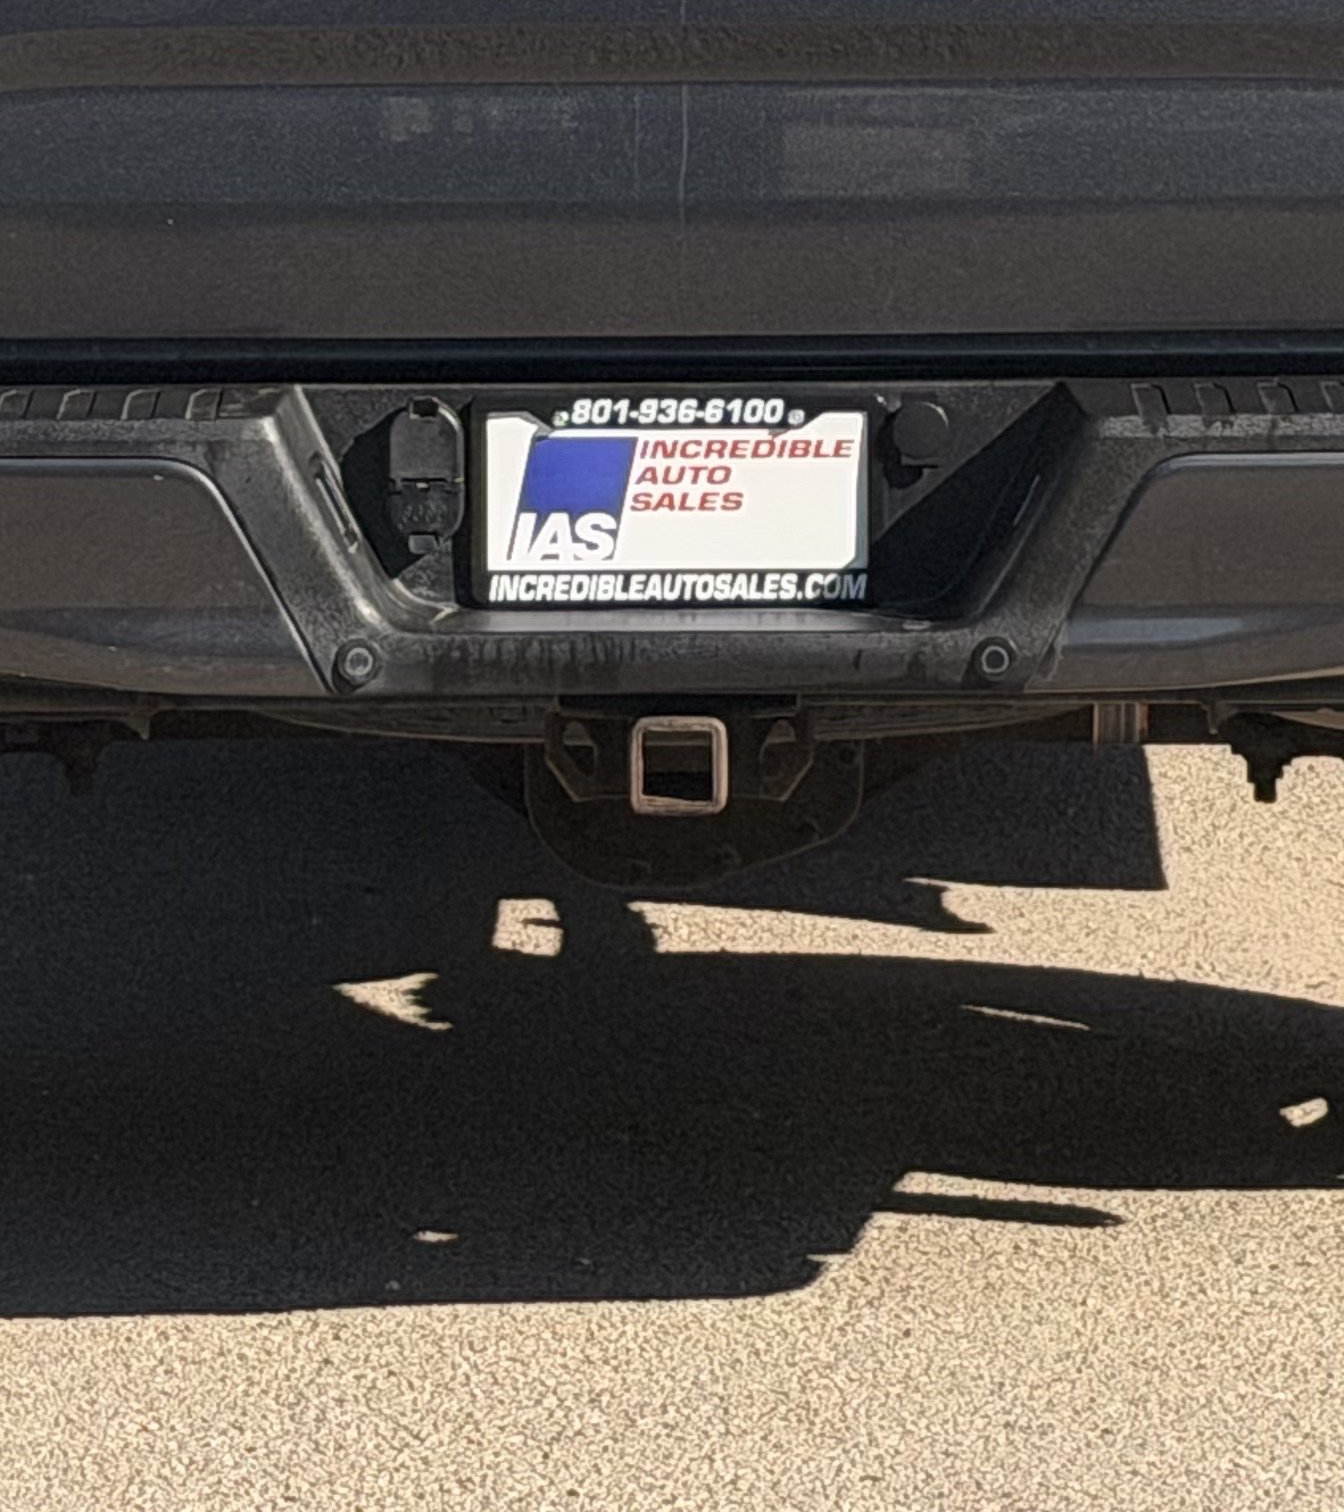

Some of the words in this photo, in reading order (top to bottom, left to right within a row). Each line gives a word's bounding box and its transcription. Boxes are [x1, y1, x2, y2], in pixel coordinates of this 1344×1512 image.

[571, 398, 784, 424] 801-936-6100
[639, 439, 855, 459] INCREDIBLE
[636, 465, 732, 485] AUTO
[630, 492, 743, 512] SALES
[489, 572, 867, 602] INCREDIBLEAUTOSALES.COM
